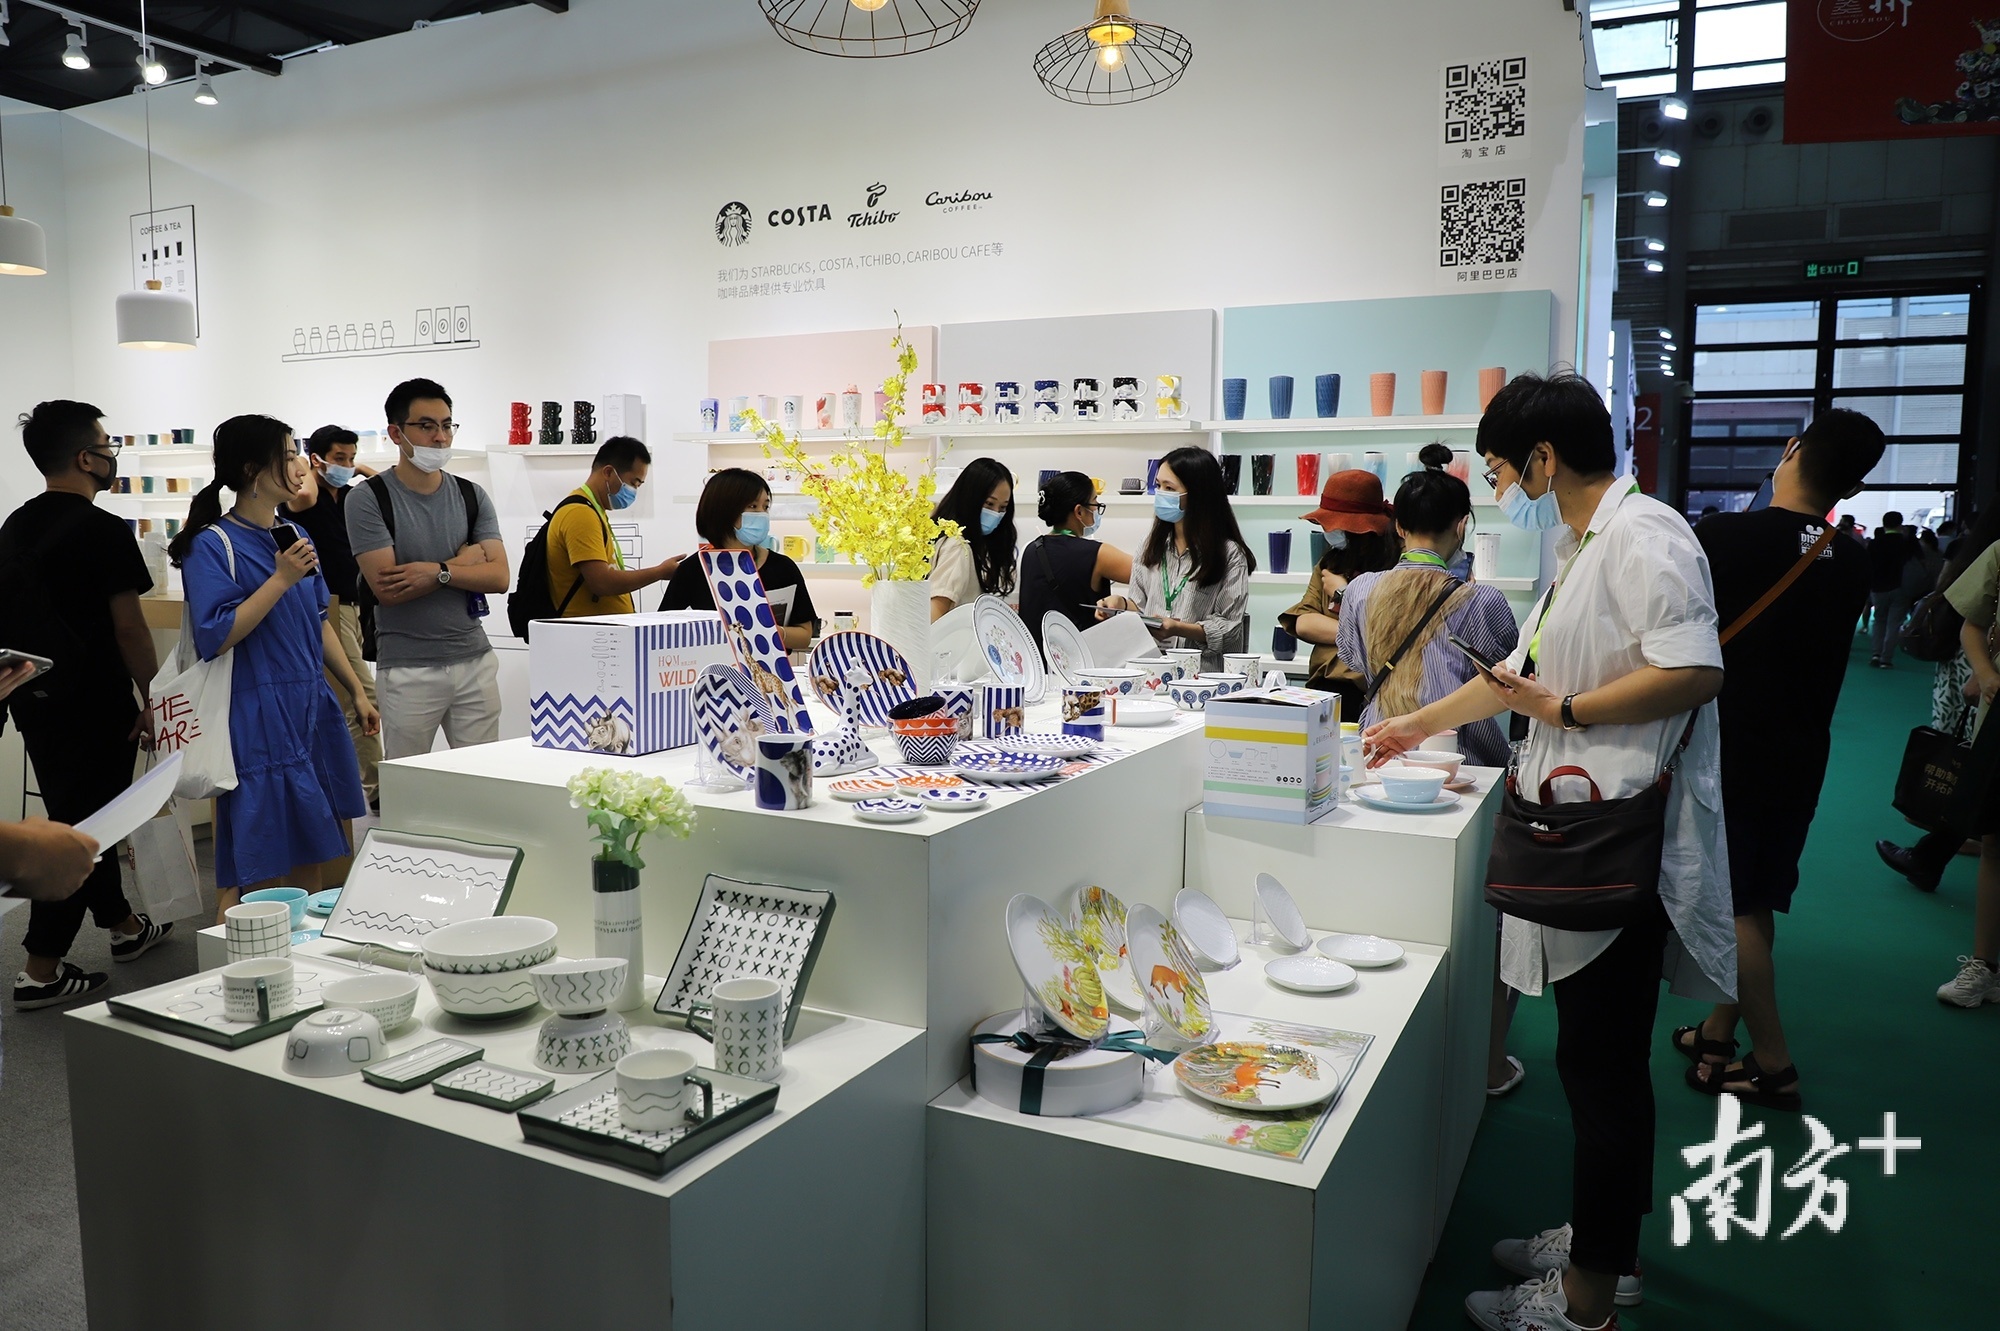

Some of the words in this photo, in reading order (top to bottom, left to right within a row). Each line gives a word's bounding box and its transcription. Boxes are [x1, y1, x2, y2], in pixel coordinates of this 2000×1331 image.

[1461, 145, 1506, 158] 淘宝店
[925, 189, 993, 206] Caribou
[768, 203, 832, 227] COSTA
[942, 204, 977, 213] COFFEE
[847, 210, 900, 228] Tchibo
[140, 224, 162, 235] COFFEE
[169, 222, 181, 231] TEA
[717, 268, 749, 283] 我们为
[1457, 268, 1518, 282] 阿里巴巴店
[1807, 263, 1818, 277] 出
[1820, 264, 1845, 275] EXIT
[717, 277, 826, 300] 咖啡品牌提供专业饮具
[658, 668, 697, 687] WILD
[157, 718, 202, 754] ARE
